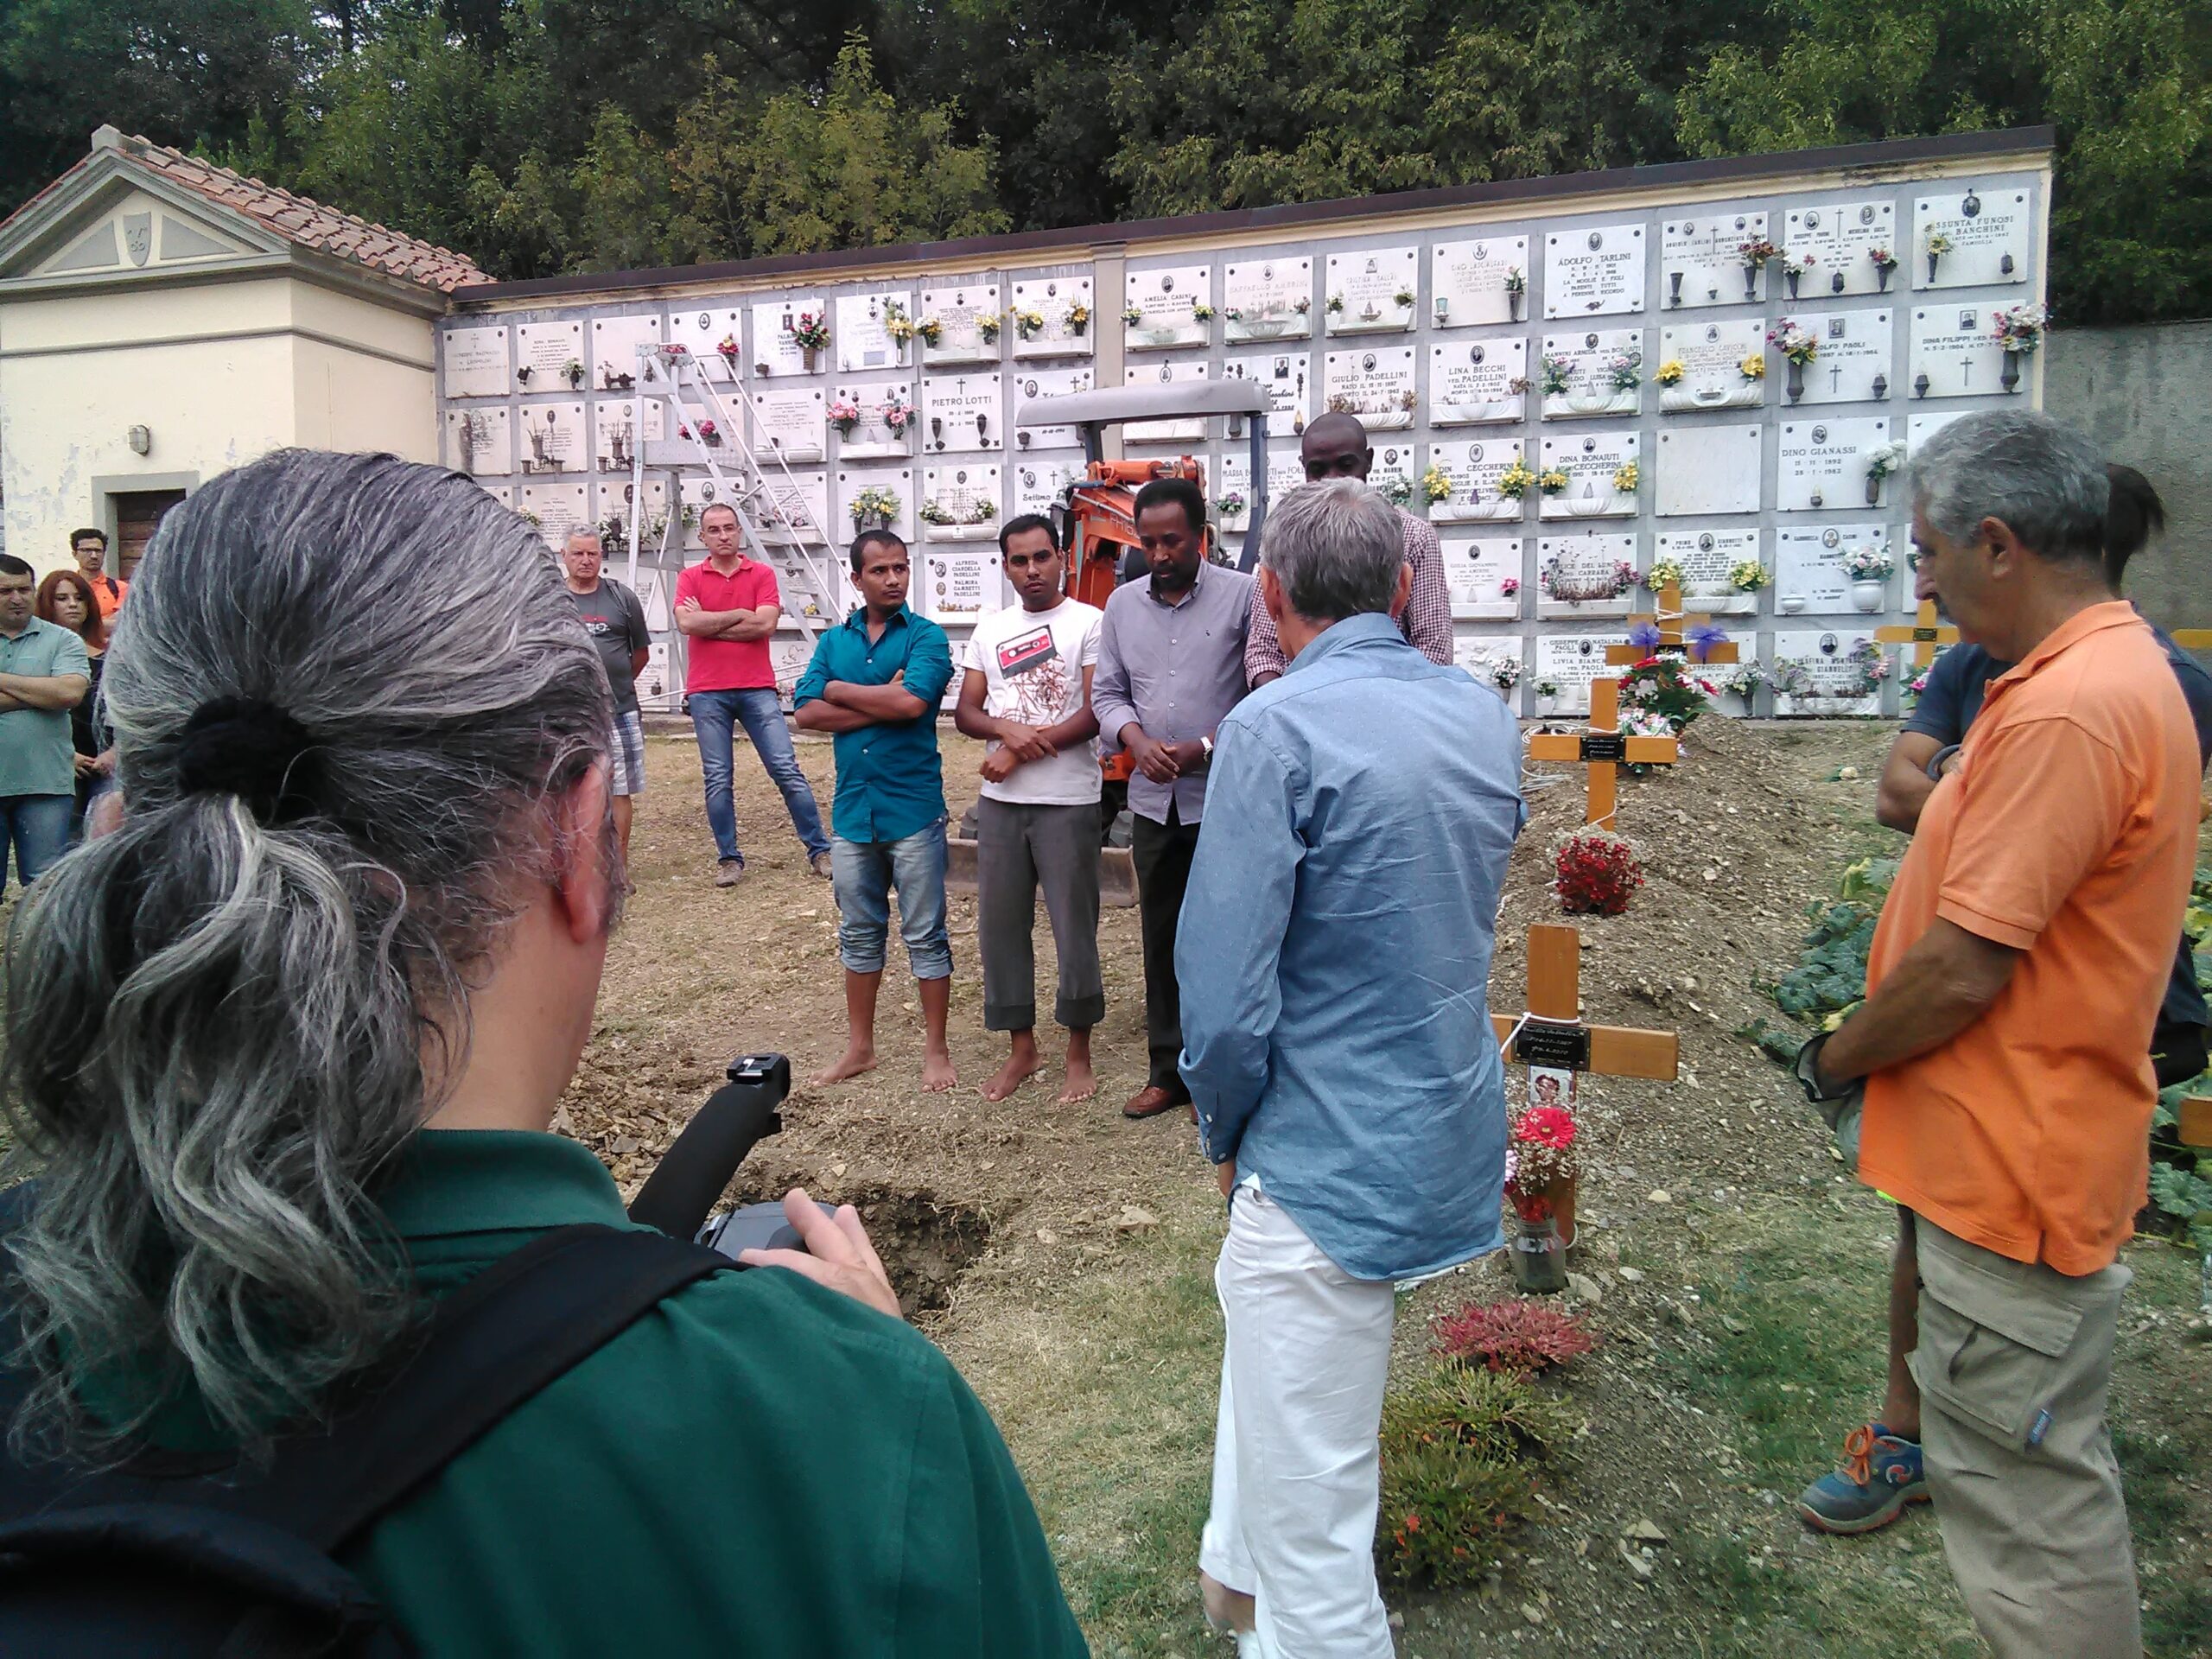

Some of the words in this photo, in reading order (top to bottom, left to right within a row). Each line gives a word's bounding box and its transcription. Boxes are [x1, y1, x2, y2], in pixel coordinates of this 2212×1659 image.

[1936, 219, 1972, 229] SSUNTA
[1956, 225, 2005, 236] BANCHINI
[1558, 257, 1592, 267] ADOLFO
[1599, 253, 1631, 263] TARLINI
[1473, 365, 1506, 373] BECCHI
[1332, 374, 1360, 384] GIULIO
[1365, 372, 1408, 381] PADELLINI
[1462, 373, 1507, 383] PADELLINI
[932, 397, 963, 407] PIETRO
[966, 396, 992, 405] LOTTI
[1782, 448, 1807, 457] DINO
[1810, 446, 1857, 455] GIANASSI
[1466, 462, 1514, 472] CECCHERINI
[1574, 461, 1622, 471] CECCHERINI
